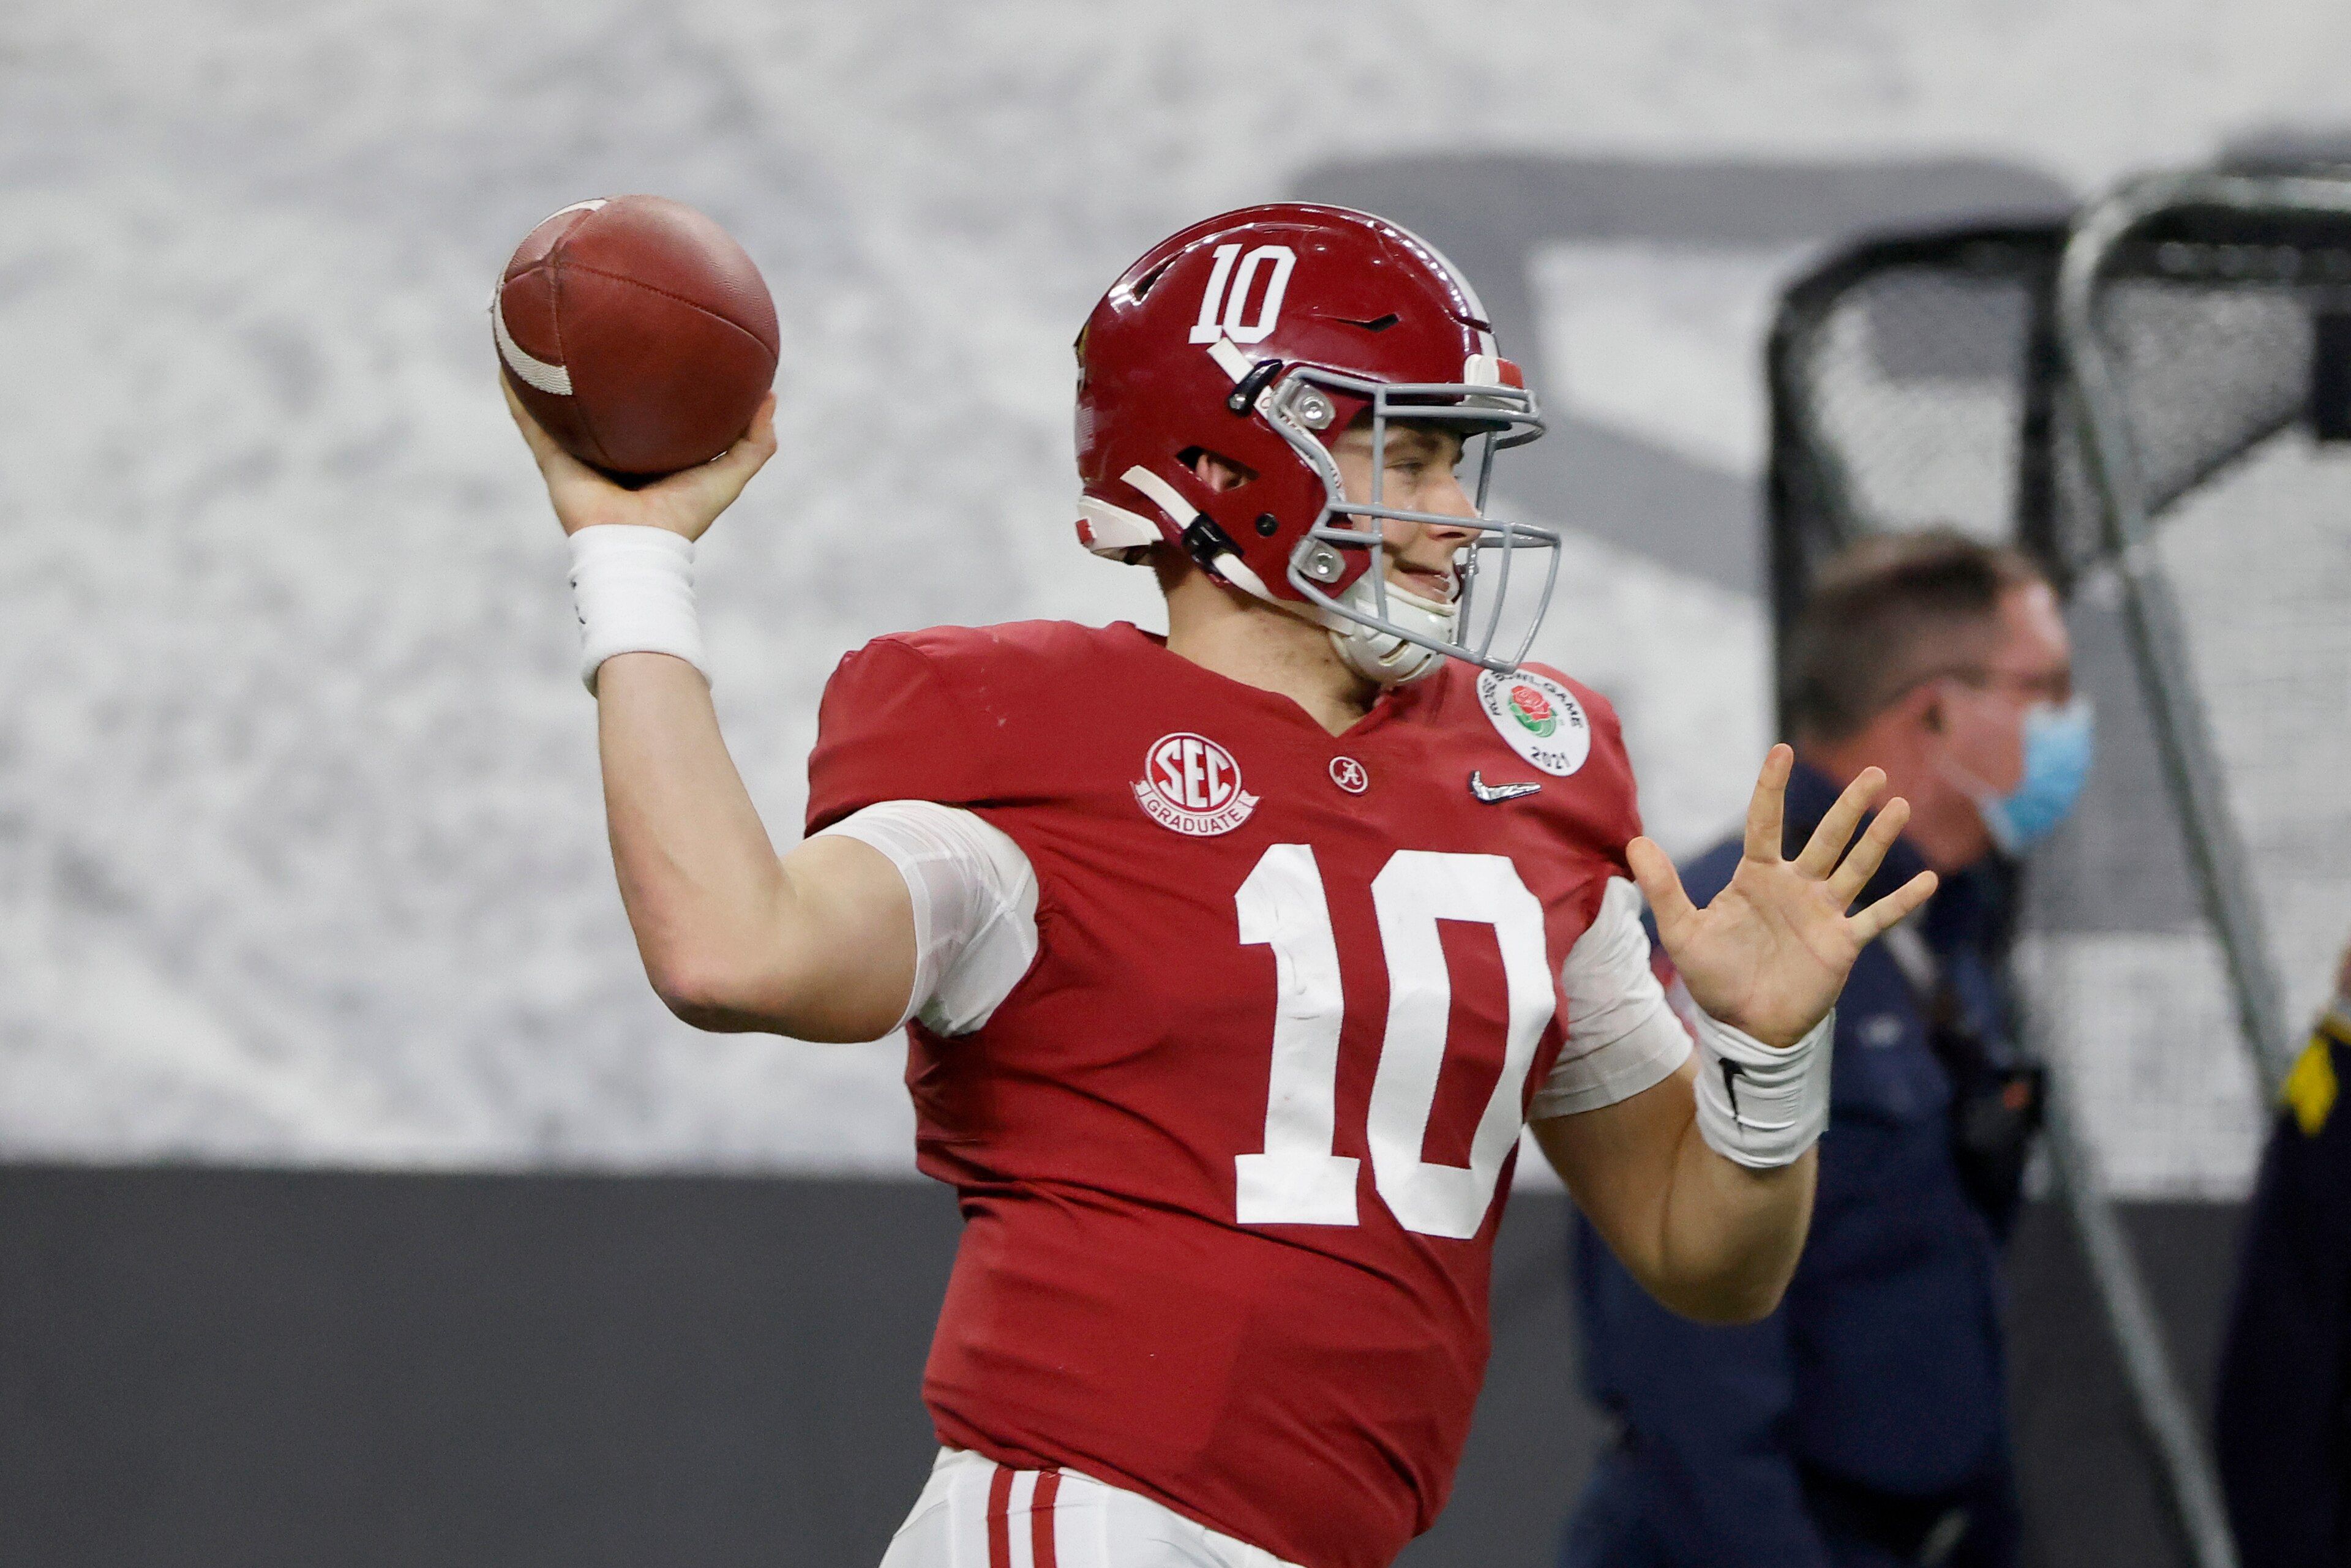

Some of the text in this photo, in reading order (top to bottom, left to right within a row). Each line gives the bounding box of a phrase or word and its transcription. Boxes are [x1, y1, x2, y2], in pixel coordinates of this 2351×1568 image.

[1188, 244, 1297, 343] 10
[1543, 682, 1583, 729] GAME
[1155, 738, 1231, 808] SEC
[1531, 746, 1570, 770] 2021
[1146, 799, 1245, 833] GRADUATE
[1234, 843, 1557, 1240] 10
